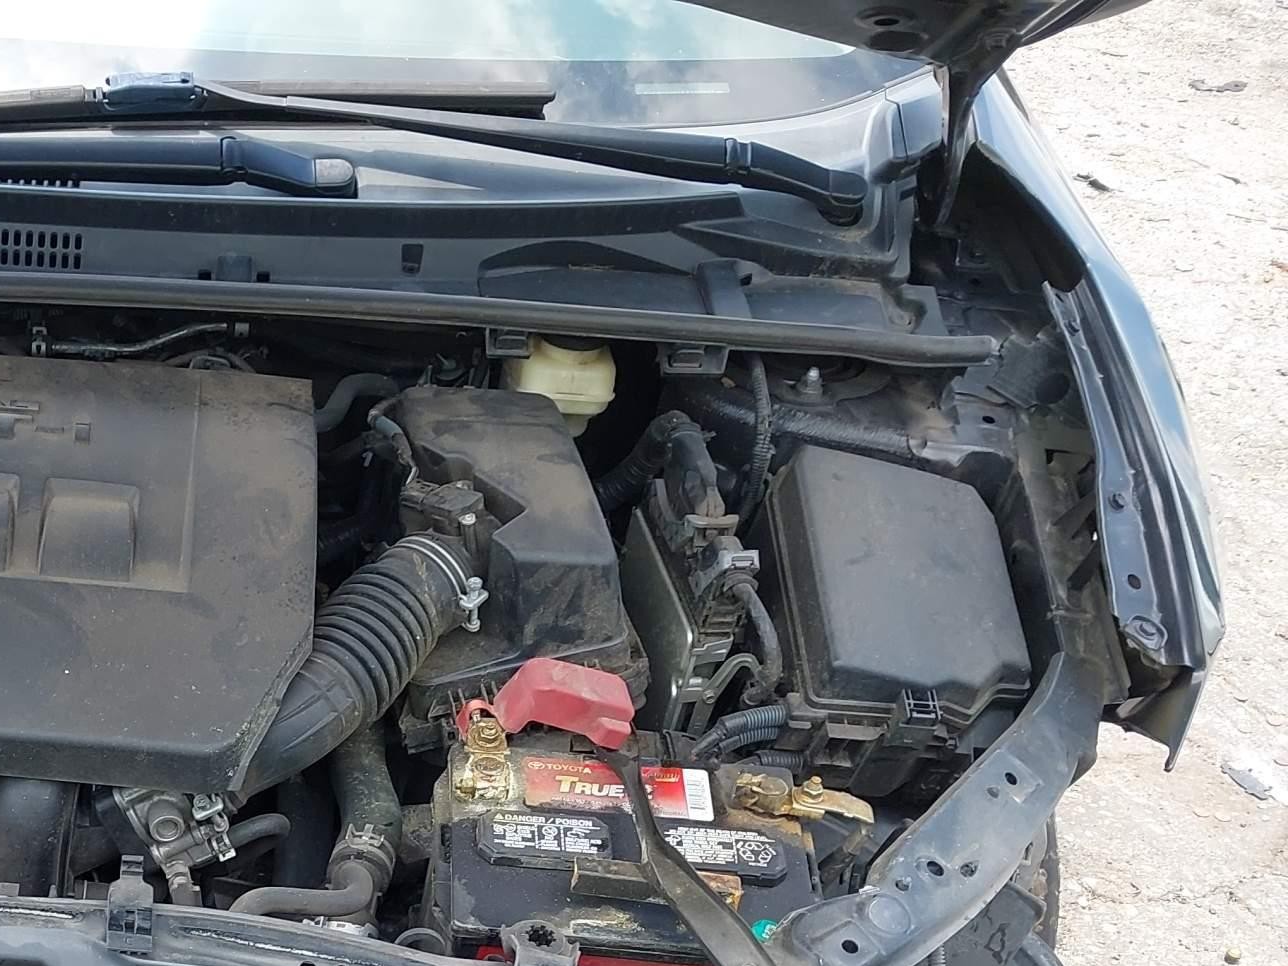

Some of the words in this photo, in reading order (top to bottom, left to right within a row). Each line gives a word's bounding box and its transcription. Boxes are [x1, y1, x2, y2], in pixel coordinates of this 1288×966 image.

[546, 763, 592, 774] TOYOTA
[505, 814, 545, 824] DANGER
[555, 818, 593, 827] POISON
